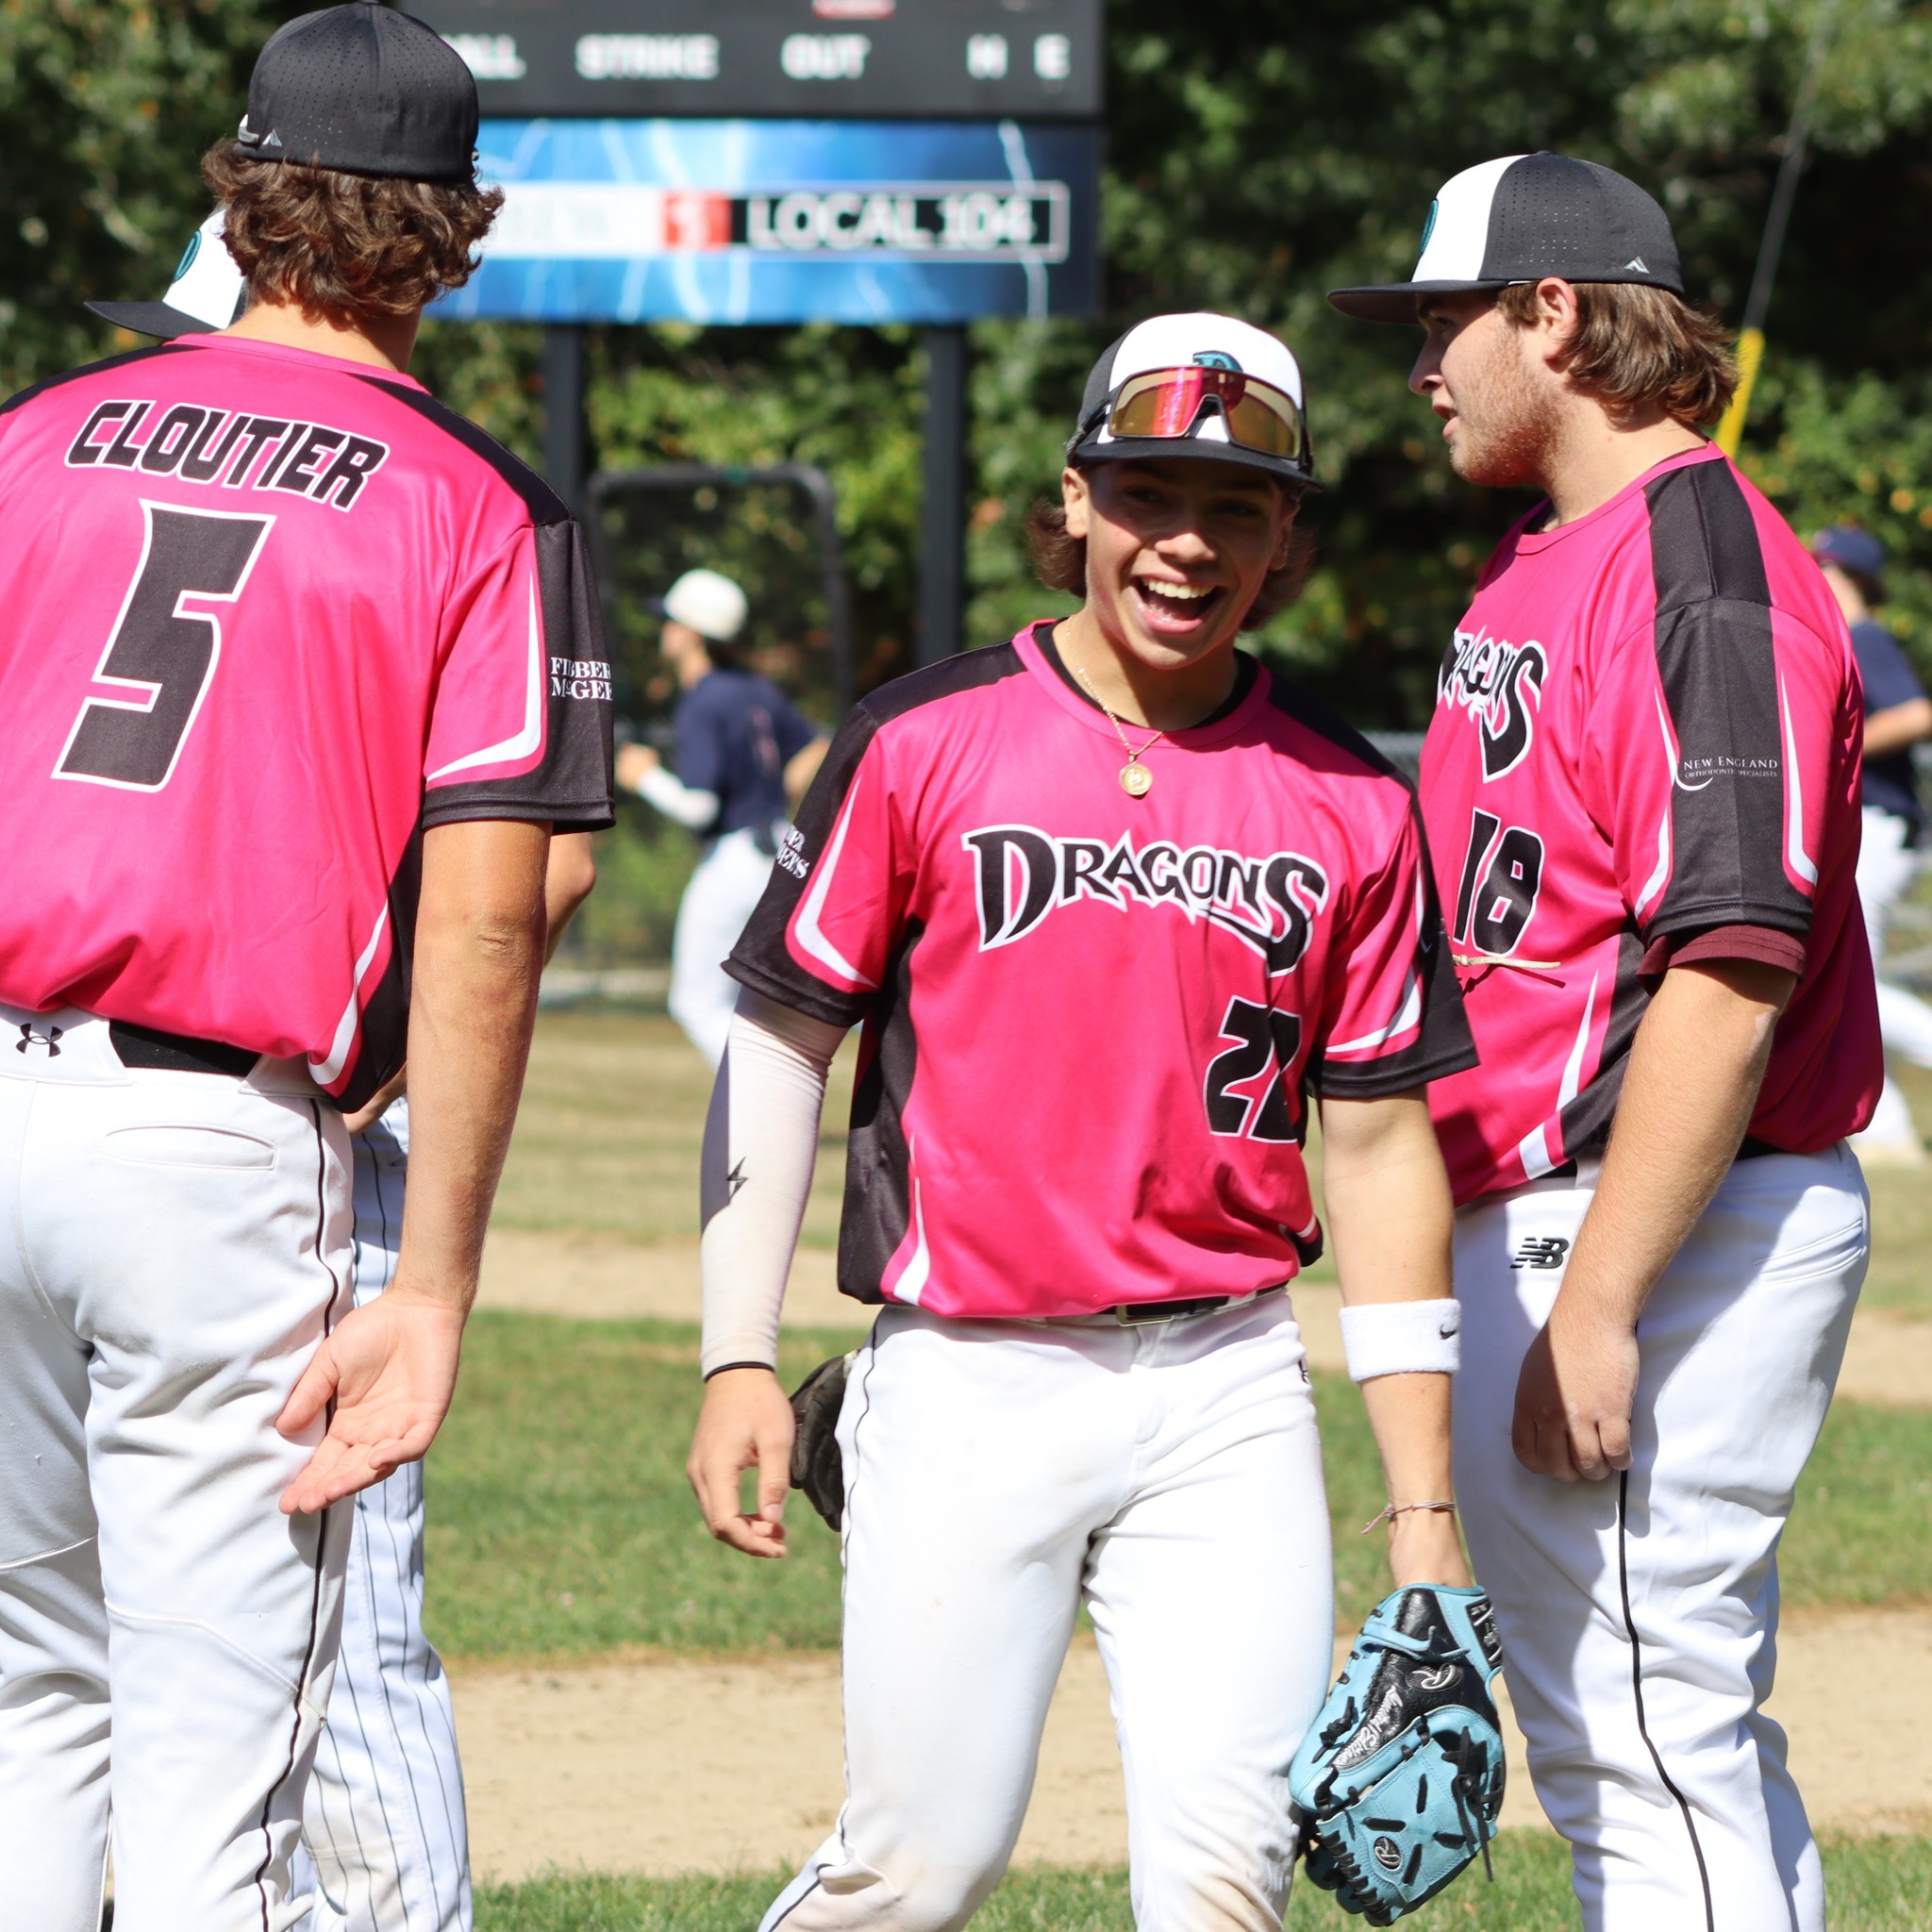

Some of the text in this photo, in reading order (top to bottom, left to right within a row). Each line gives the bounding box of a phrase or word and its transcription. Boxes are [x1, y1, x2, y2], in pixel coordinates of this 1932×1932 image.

[439, 34, 527, 79] ALL
[575, 34, 721, 79] STRIKE
[780, 33, 872, 79] OUT
[1034, 34, 1072, 79] E
[747, 192, 935, 251] LOCAL
[64, 399, 390, 513] CLOUTIER
[51, 497, 277, 793] 5
[1684, 756, 1778, 772] NEW ENGLAND
[960, 824, 1329, 978] DRAGONS
[1453, 807, 1545, 957] 18
